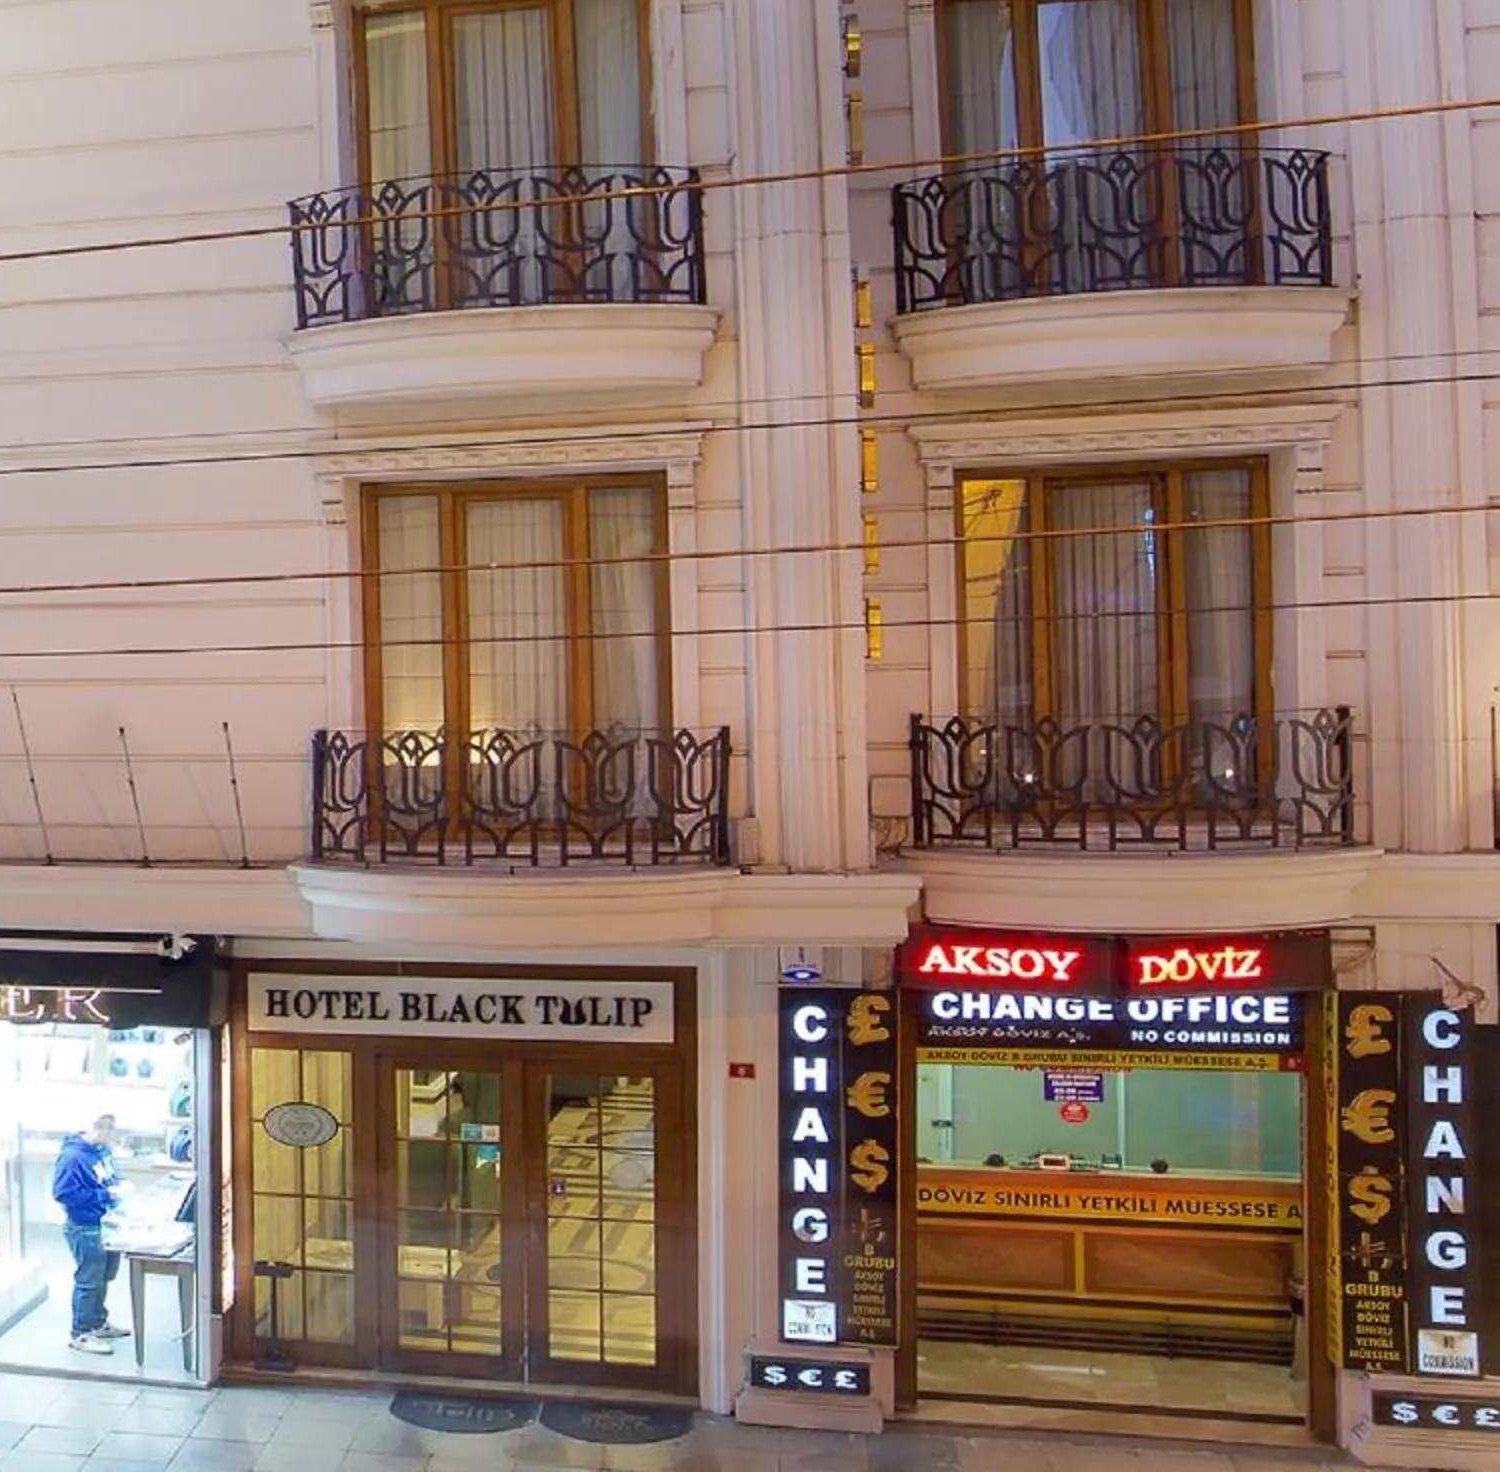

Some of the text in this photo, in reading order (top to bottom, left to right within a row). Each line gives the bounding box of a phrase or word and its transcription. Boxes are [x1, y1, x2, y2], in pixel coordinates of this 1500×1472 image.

[919, 944, 1080, 981] AKSOY
[1139, 946, 1263, 985] DÖVİZ
[266, 989, 653, 1027] HOTEL BLACK TULIP
[932, 991, 1290, 1024] CHANGE OFFICE
[1131, 1030, 1290, 1044] NO COMMISSION
[793, 1005, 828, 1293] CHANGE
[1422, 1010, 1468, 1325] CHANGE
[843, 1255, 895, 1269] GRUBU
[1345, 1283, 1403, 1299] GRUBU
